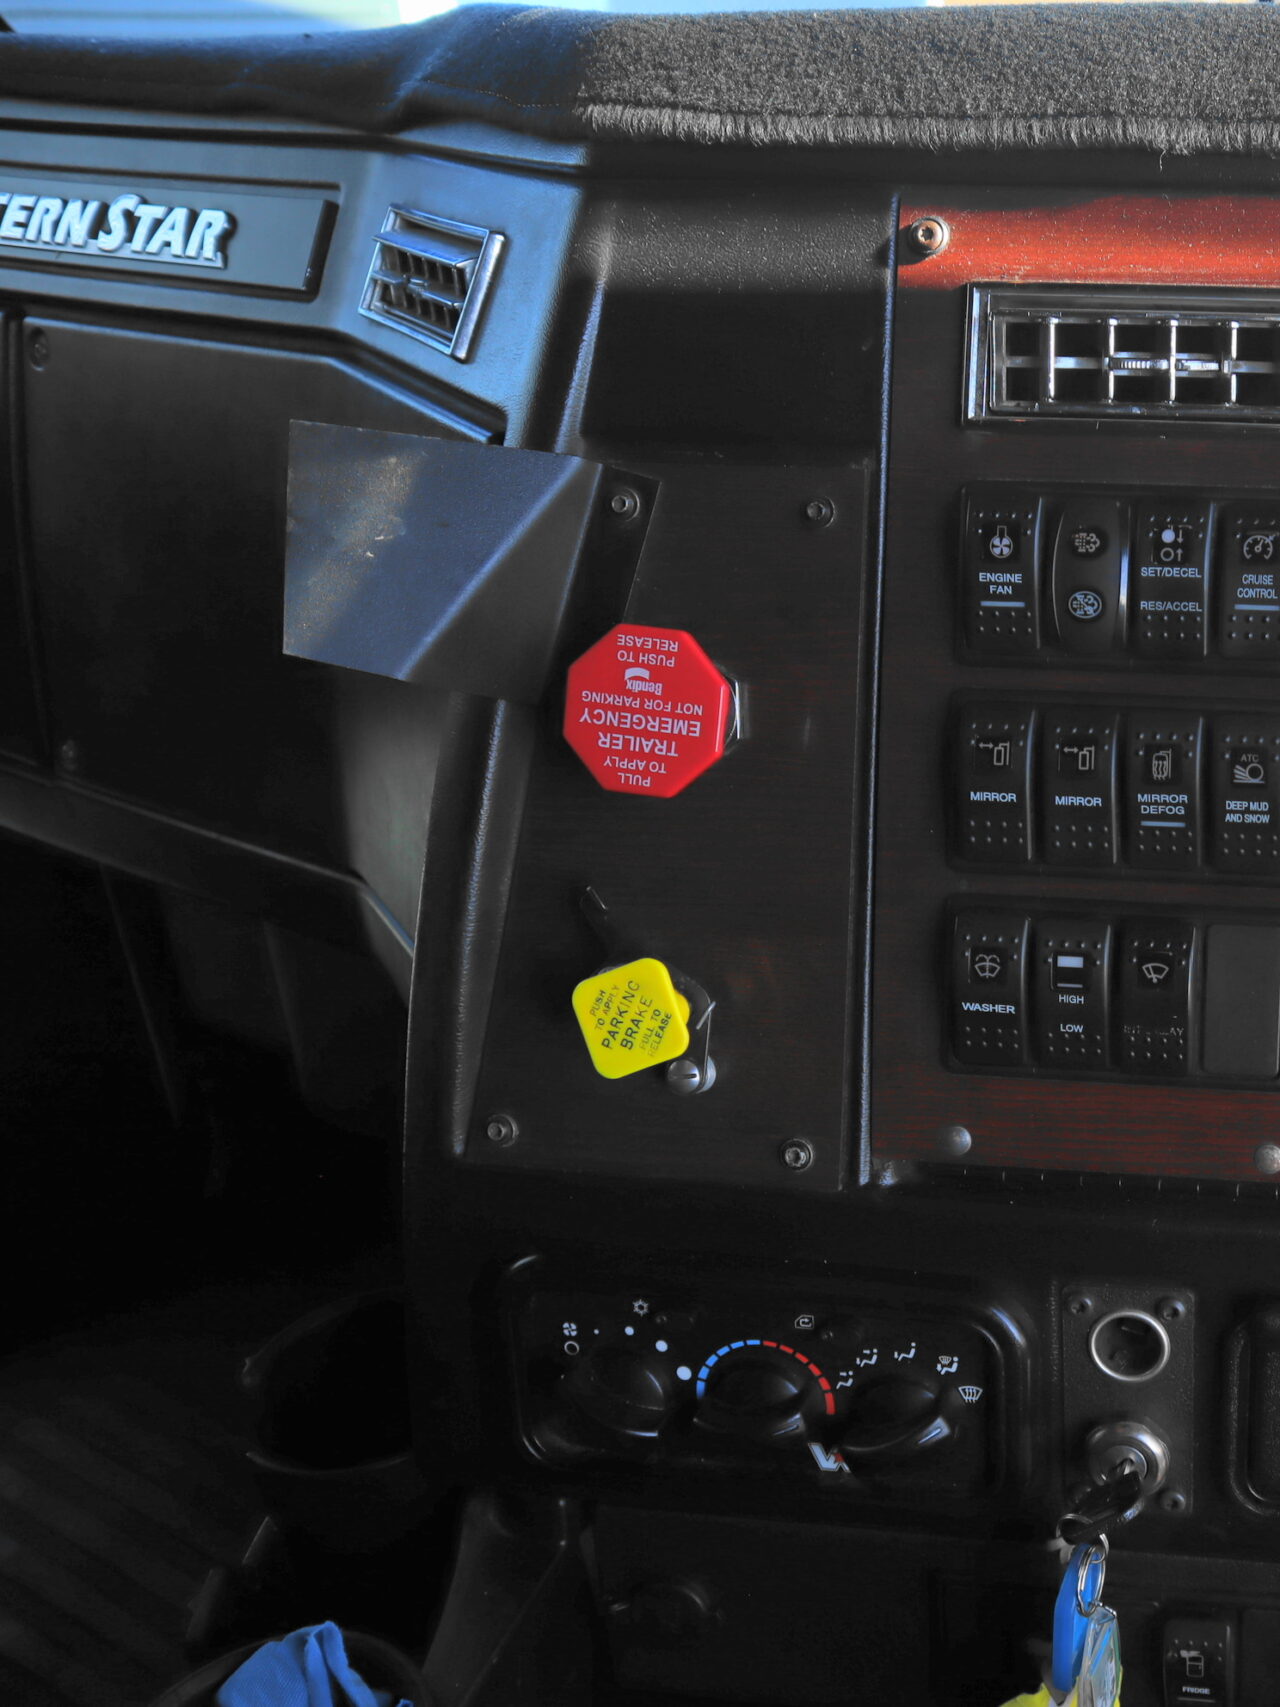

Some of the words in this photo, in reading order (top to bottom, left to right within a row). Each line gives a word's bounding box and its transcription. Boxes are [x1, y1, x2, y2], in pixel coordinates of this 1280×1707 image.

[978, 572, 1022, 584] ENGINE
[1140, 567, 1202, 578] SET/DECEL
[1242, 574, 1274, 586] CRUISE
[989, 585, 1012, 595] FAN
[1237, 588, 1278, 600] CONTROL
[1139, 601, 1202, 612] RES/ACCEL
[617, 634, 678, 652] RELEASE
[617, 650, 634, 662] TO
[639, 653, 675, 667] PUSH
[626, 680, 662, 694] Bendix
[582, 690, 640, 708] PARKING
[644, 698, 670, 712] FOR
[674, 701, 702, 715] NOT
[580, 708, 701, 736] EMERGENCY
[598, 732, 678, 756] TRAILER
[604, 756, 644, 770] APPLY
[649, 761, 667, 773] TO
[618, 772, 651, 787] PULL
[970, 791, 1017, 803] MIRROR
[1055, 795, 1102, 808] MIRROR
[1137, 793, 1188, 804] MIRROR
[1140, 805, 1185, 816] DEFOG
[1226, 800, 1247, 812] DEEP
[1249, 801, 1269, 812] MUD
[1225, 813, 1242, 824] AND
[1244, 813, 1270, 824] SNOW
[589, 990, 607, 1017] PUSH
[1058, 994, 1085, 1005] HIGH
[595, 1018, 606, 1030] TO
[603, 984, 621, 1015] APPLY
[962, 1002, 1015, 1015] WASHER
[601, 980, 640, 1050] PARKING
[650, 1009, 661, 1022] TO
[620, 996, 654, 1050] BRAKE
[1060, 1024, 1084, 1033] LOW
[647, 1013, 672, 1058] RELEASE
